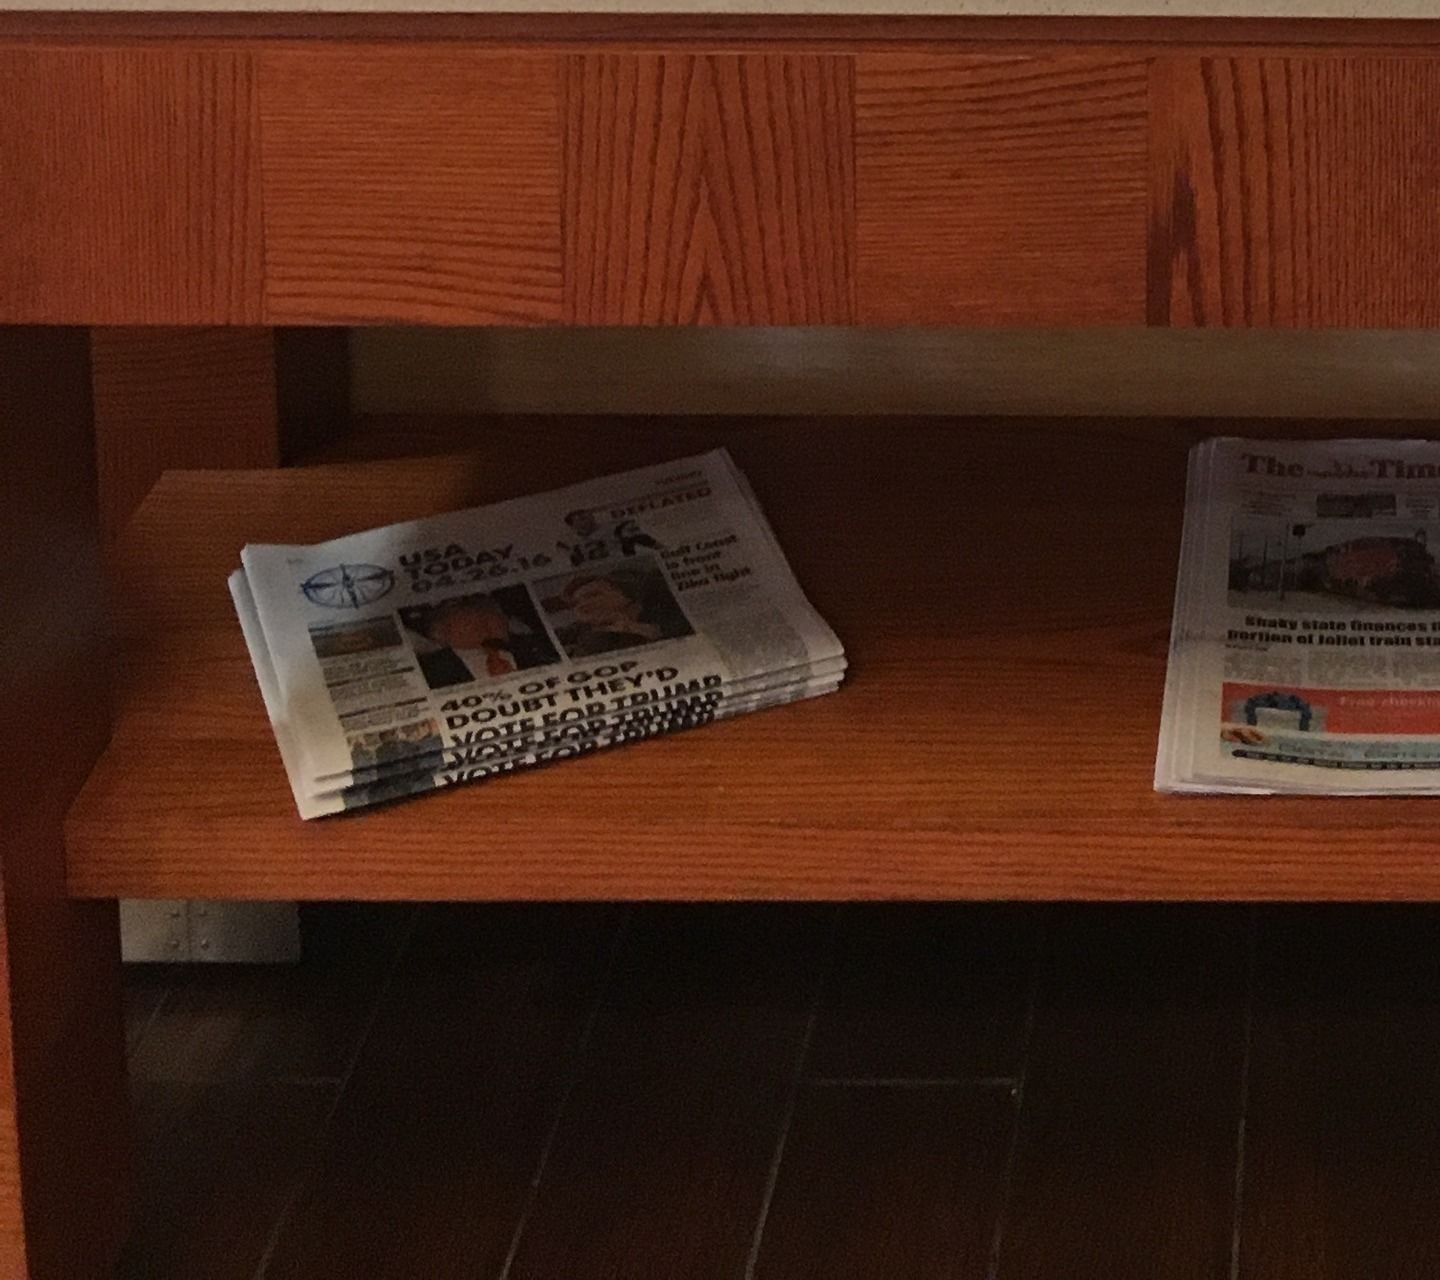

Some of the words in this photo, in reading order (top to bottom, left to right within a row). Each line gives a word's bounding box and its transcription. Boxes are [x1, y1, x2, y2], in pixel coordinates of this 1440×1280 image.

[1241, 453, 1305, 478] The
[398, 543, 465, 568] USA
[402, 543, 515, 581] TODAY
[1302, 618, 1347, 631] state
[1350, 619, 1427, 632] finances
[1227, 629, 1292, 644] portion
[1296, 633, 1314, 645] of
[1369, 635, 1412, 647] train
[440, 690, 512, 713] 40%
[518, 676, 561, 696] OF
[566, 660, 638, 684] GOP
[446, 692, 558, 731] DOUBT
[563, 665, 679, 702] THEY'D
